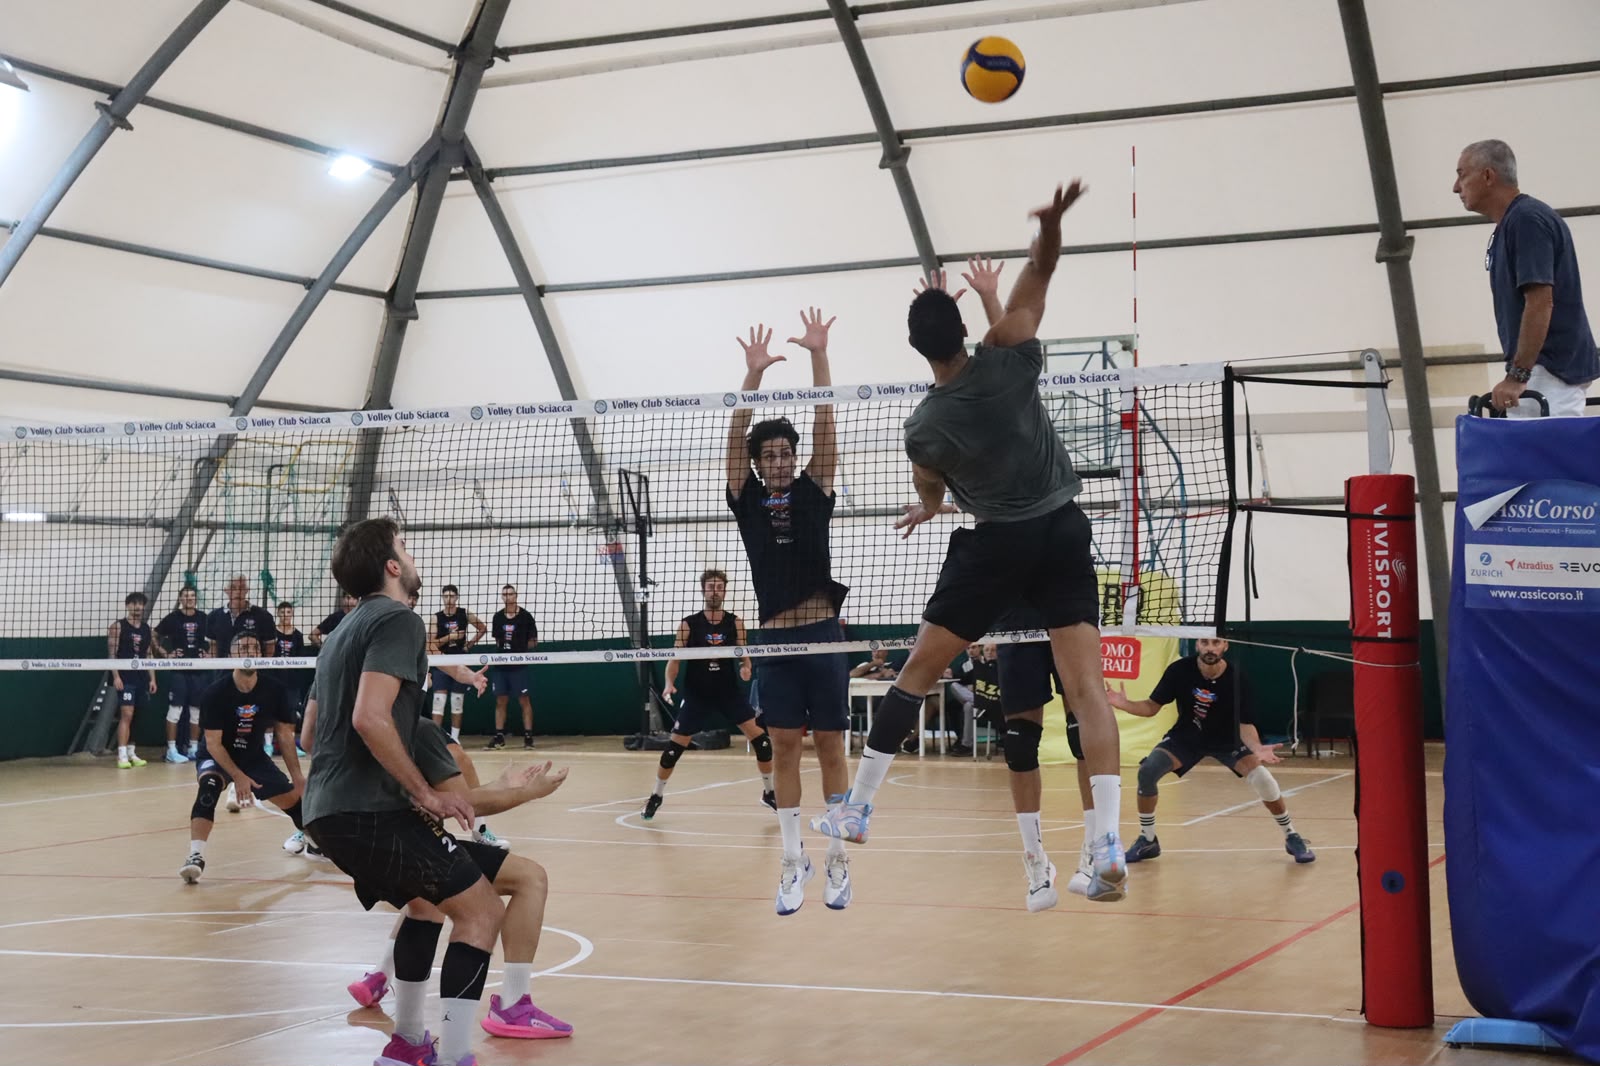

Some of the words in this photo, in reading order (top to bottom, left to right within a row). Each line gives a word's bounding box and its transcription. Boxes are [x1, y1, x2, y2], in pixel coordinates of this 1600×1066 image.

[1052, 374, 1076, 385] Club
[1079, 372, 1120, 383] Sciacca
[741, 393, 769, 404] Volley
[771, 391, 793, 402] Club
[796, 389, 834, 400] Sciacca
[876, 385, 906, 396] Volley
[612, 400, 638, 410] Volley
[641, 398, 662, 409] Club
[664, 397, 700, 407] Sciacca
[367, 412, 392, 422] Volley
[394, 410, 415, 421] Club
[416, 410, 449, 419] Sciacca
[487, 406, 513, 417] Volley
[515, 405, 537, 415] Club
[538, 403, 573, 414] Sciacca
[139, 423, 163, 432] Volley
[165, 422, 183, 431] Club
[186, 421, 216, 430] Sciacca
[251, 417, 277, 428] Volley
[278, 416, 297, 426] Club
[299, 415, 331, 425] Sciacca
[30, 427, 53, 436] Volley
[54, 426, 73, 435] Club
[75, 425, 105, 434] Sciacca
[1373, 503, 1392, 638] VIVISPORT
[1517, 561, 1554, 571] Atradius
[1470, 569, 1503, 577] ZURICH
[1489, 589, 1584, 601] www.assicorso.it
[441, 836, 457, 853] 2
